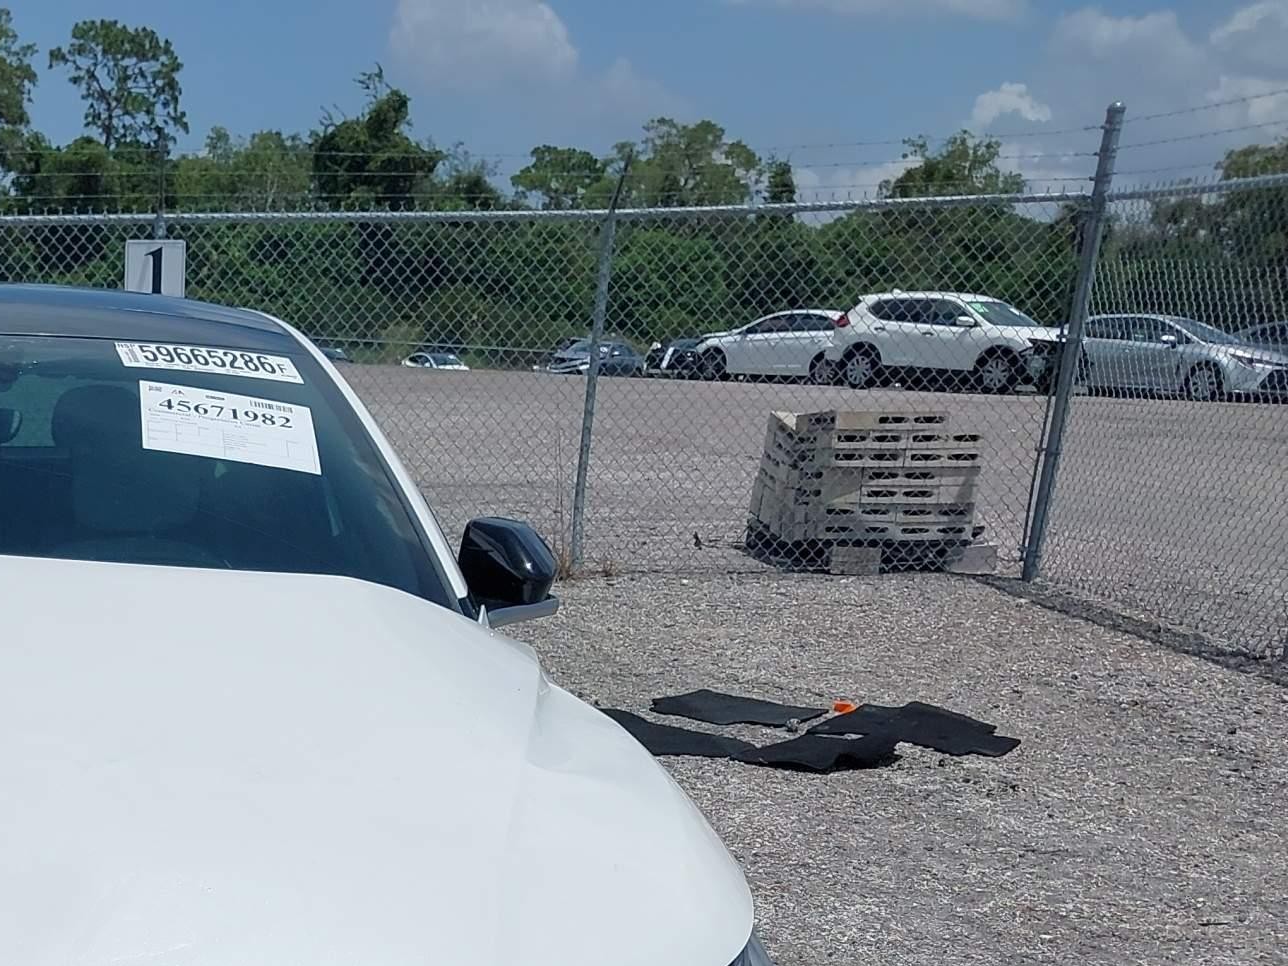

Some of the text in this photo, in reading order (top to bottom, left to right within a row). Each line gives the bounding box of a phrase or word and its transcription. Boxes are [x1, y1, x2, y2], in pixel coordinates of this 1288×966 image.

[143, 246, 163, 294] 1
[138, 345, 277, 375] 59665286
[158, 398, 293, 428] 45671982
